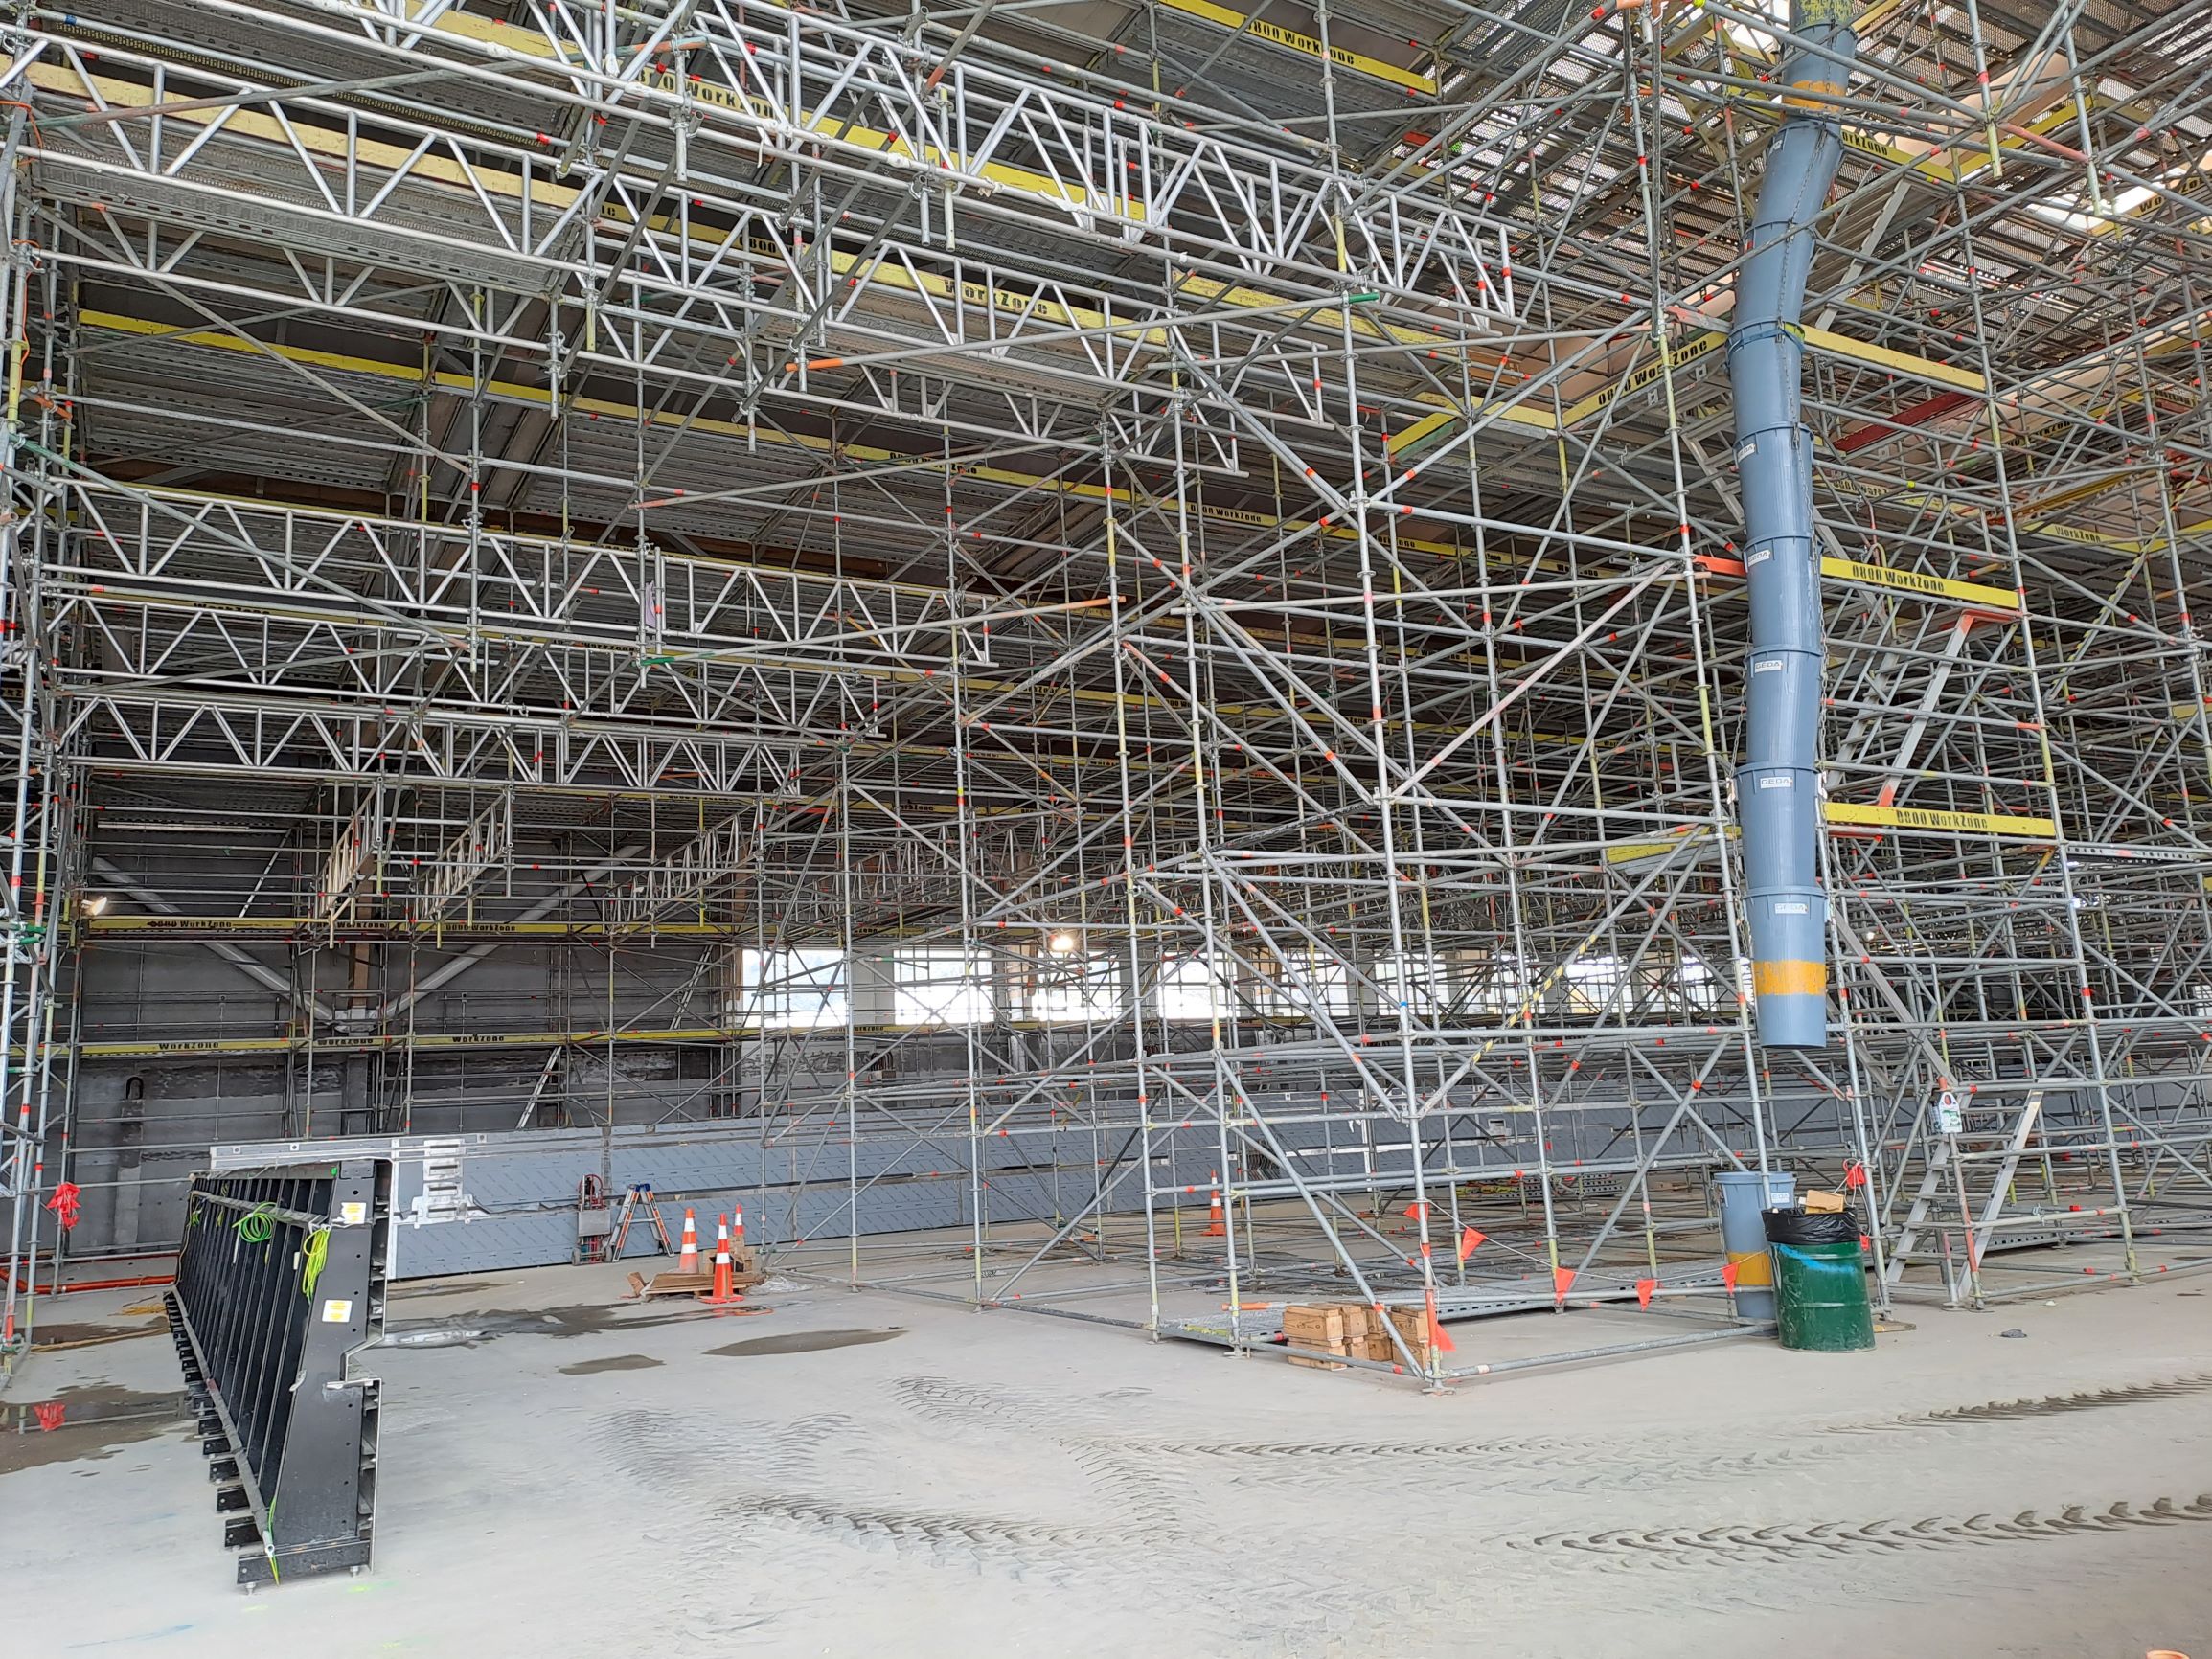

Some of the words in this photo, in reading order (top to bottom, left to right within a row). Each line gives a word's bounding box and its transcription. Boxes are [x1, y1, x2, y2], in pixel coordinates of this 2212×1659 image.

[1284, 30, 1355, 64] Workone
[1842, 131, 1887, 156] orkZone
[1598, 381, 1631, 406] 080
[1634, 340, 1708, 388] WoZone
[1191, 504, 1214, 514] 000
[1852, 564, 1882, 582] 0800
[1884, 570, 1945, 593] WorkZone
[1755, 661, 1780, 670] GEDA
[1896, 809, 1927, 826] 0800
[1929, 812, 1988, 830] WorkZone
